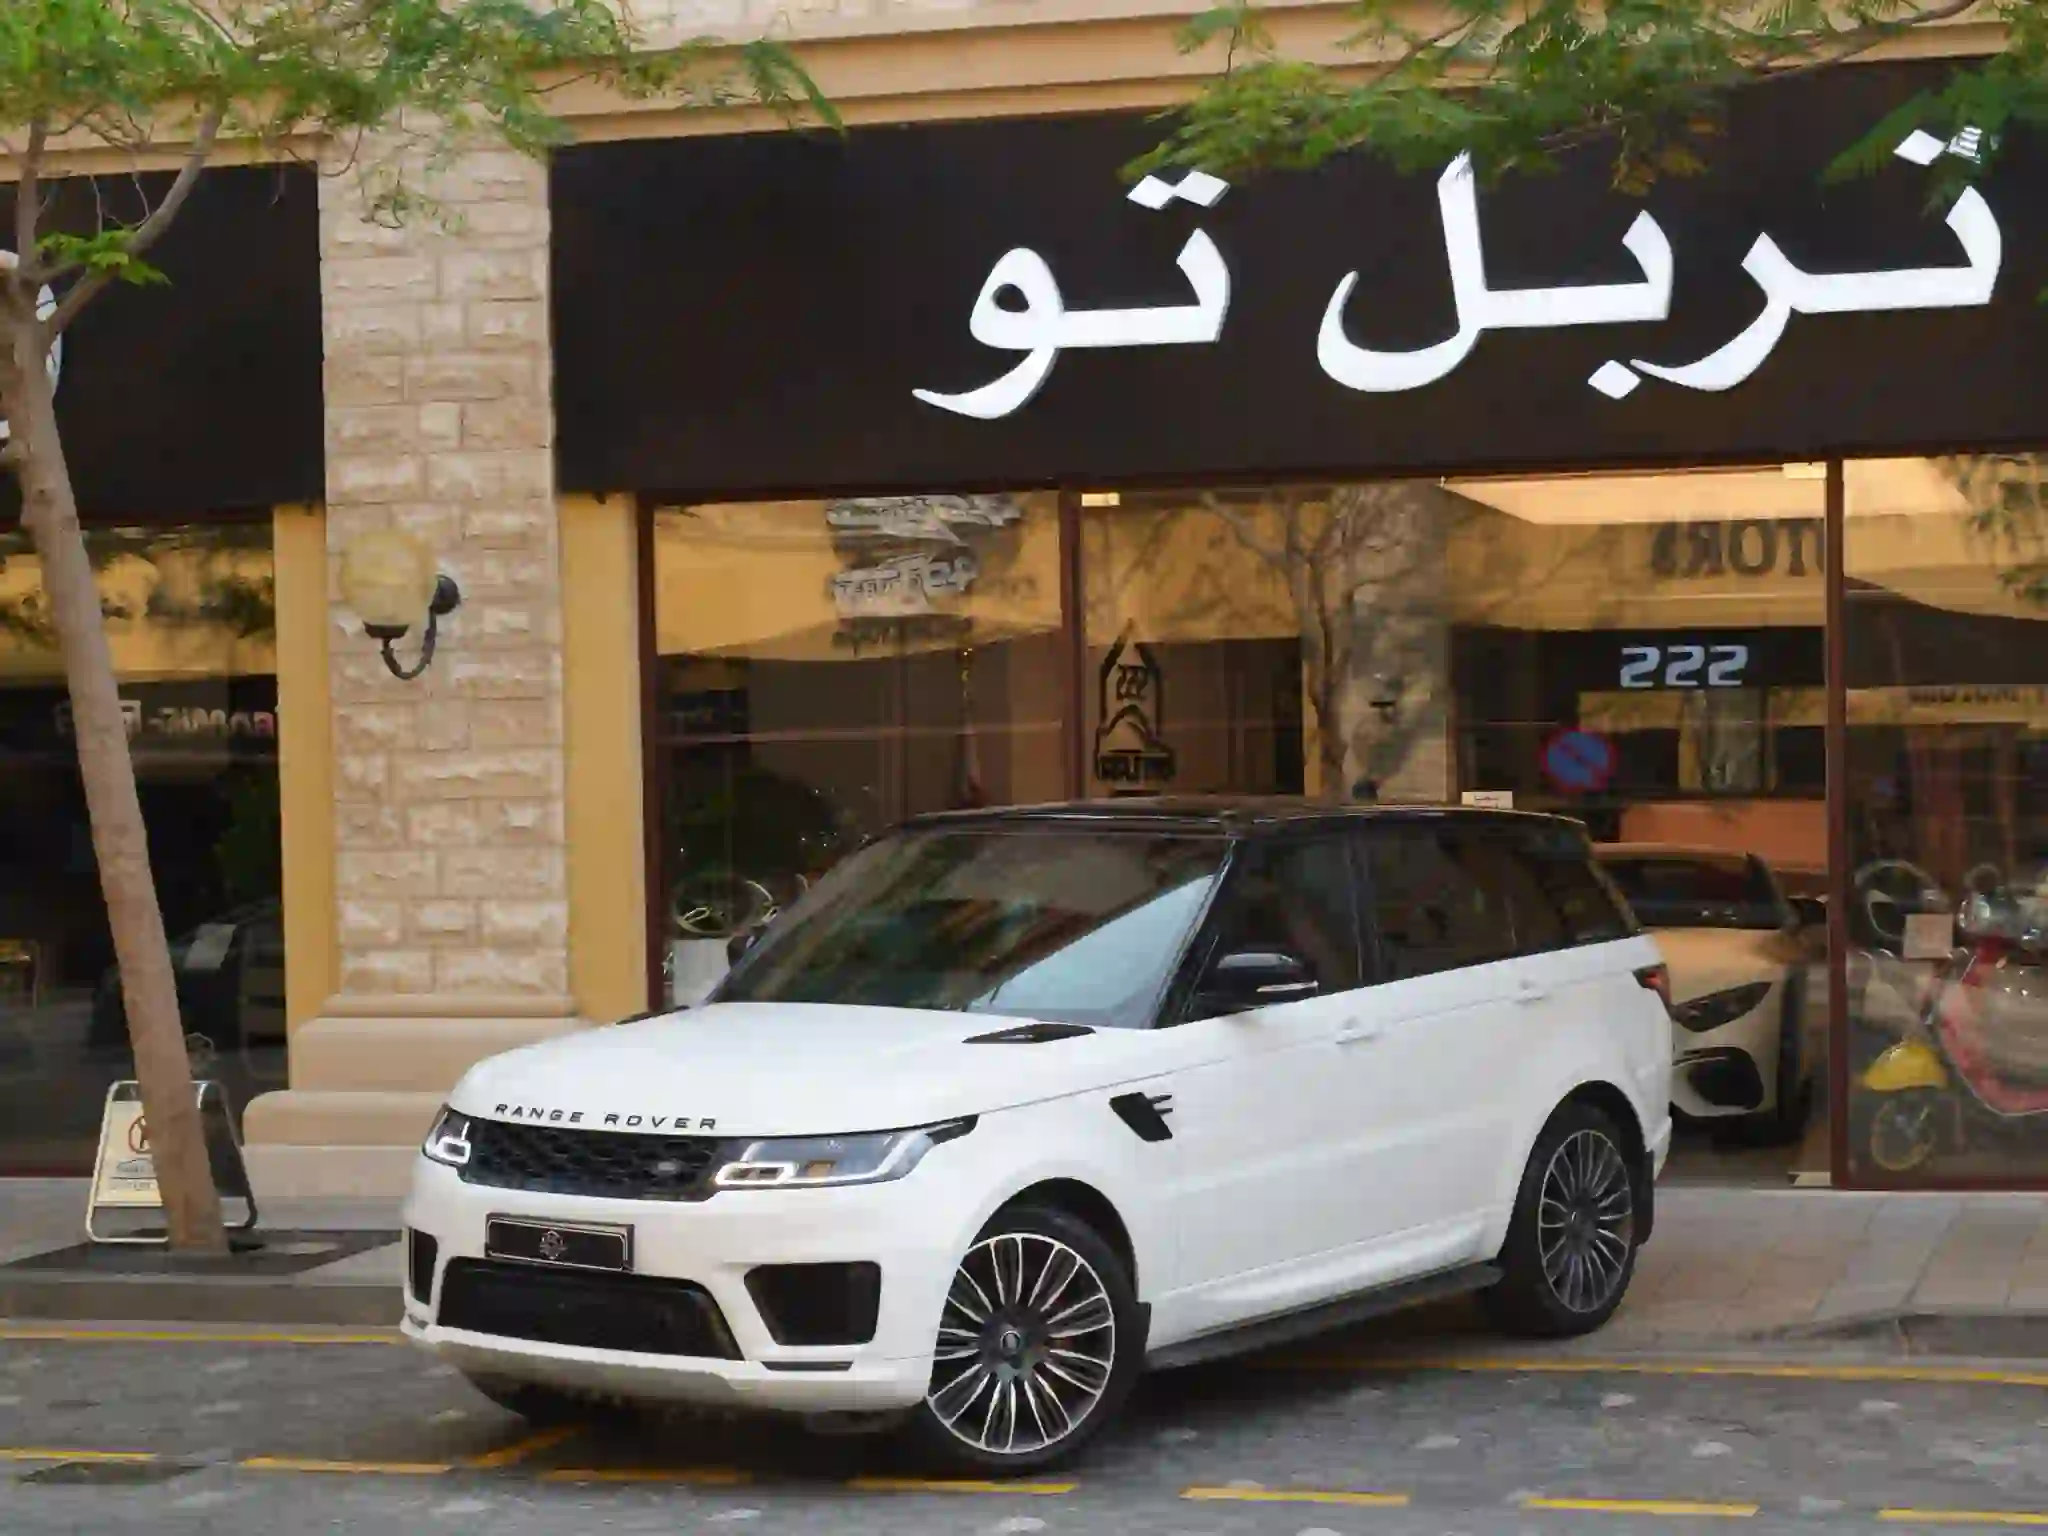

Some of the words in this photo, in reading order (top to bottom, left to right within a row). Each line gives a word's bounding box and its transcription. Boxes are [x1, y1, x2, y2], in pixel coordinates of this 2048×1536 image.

[912, 170, 1231, 419] تو
[495, 1103, 584, 1124] RANGE
[604, 1113, 717, 1130] ROVER
